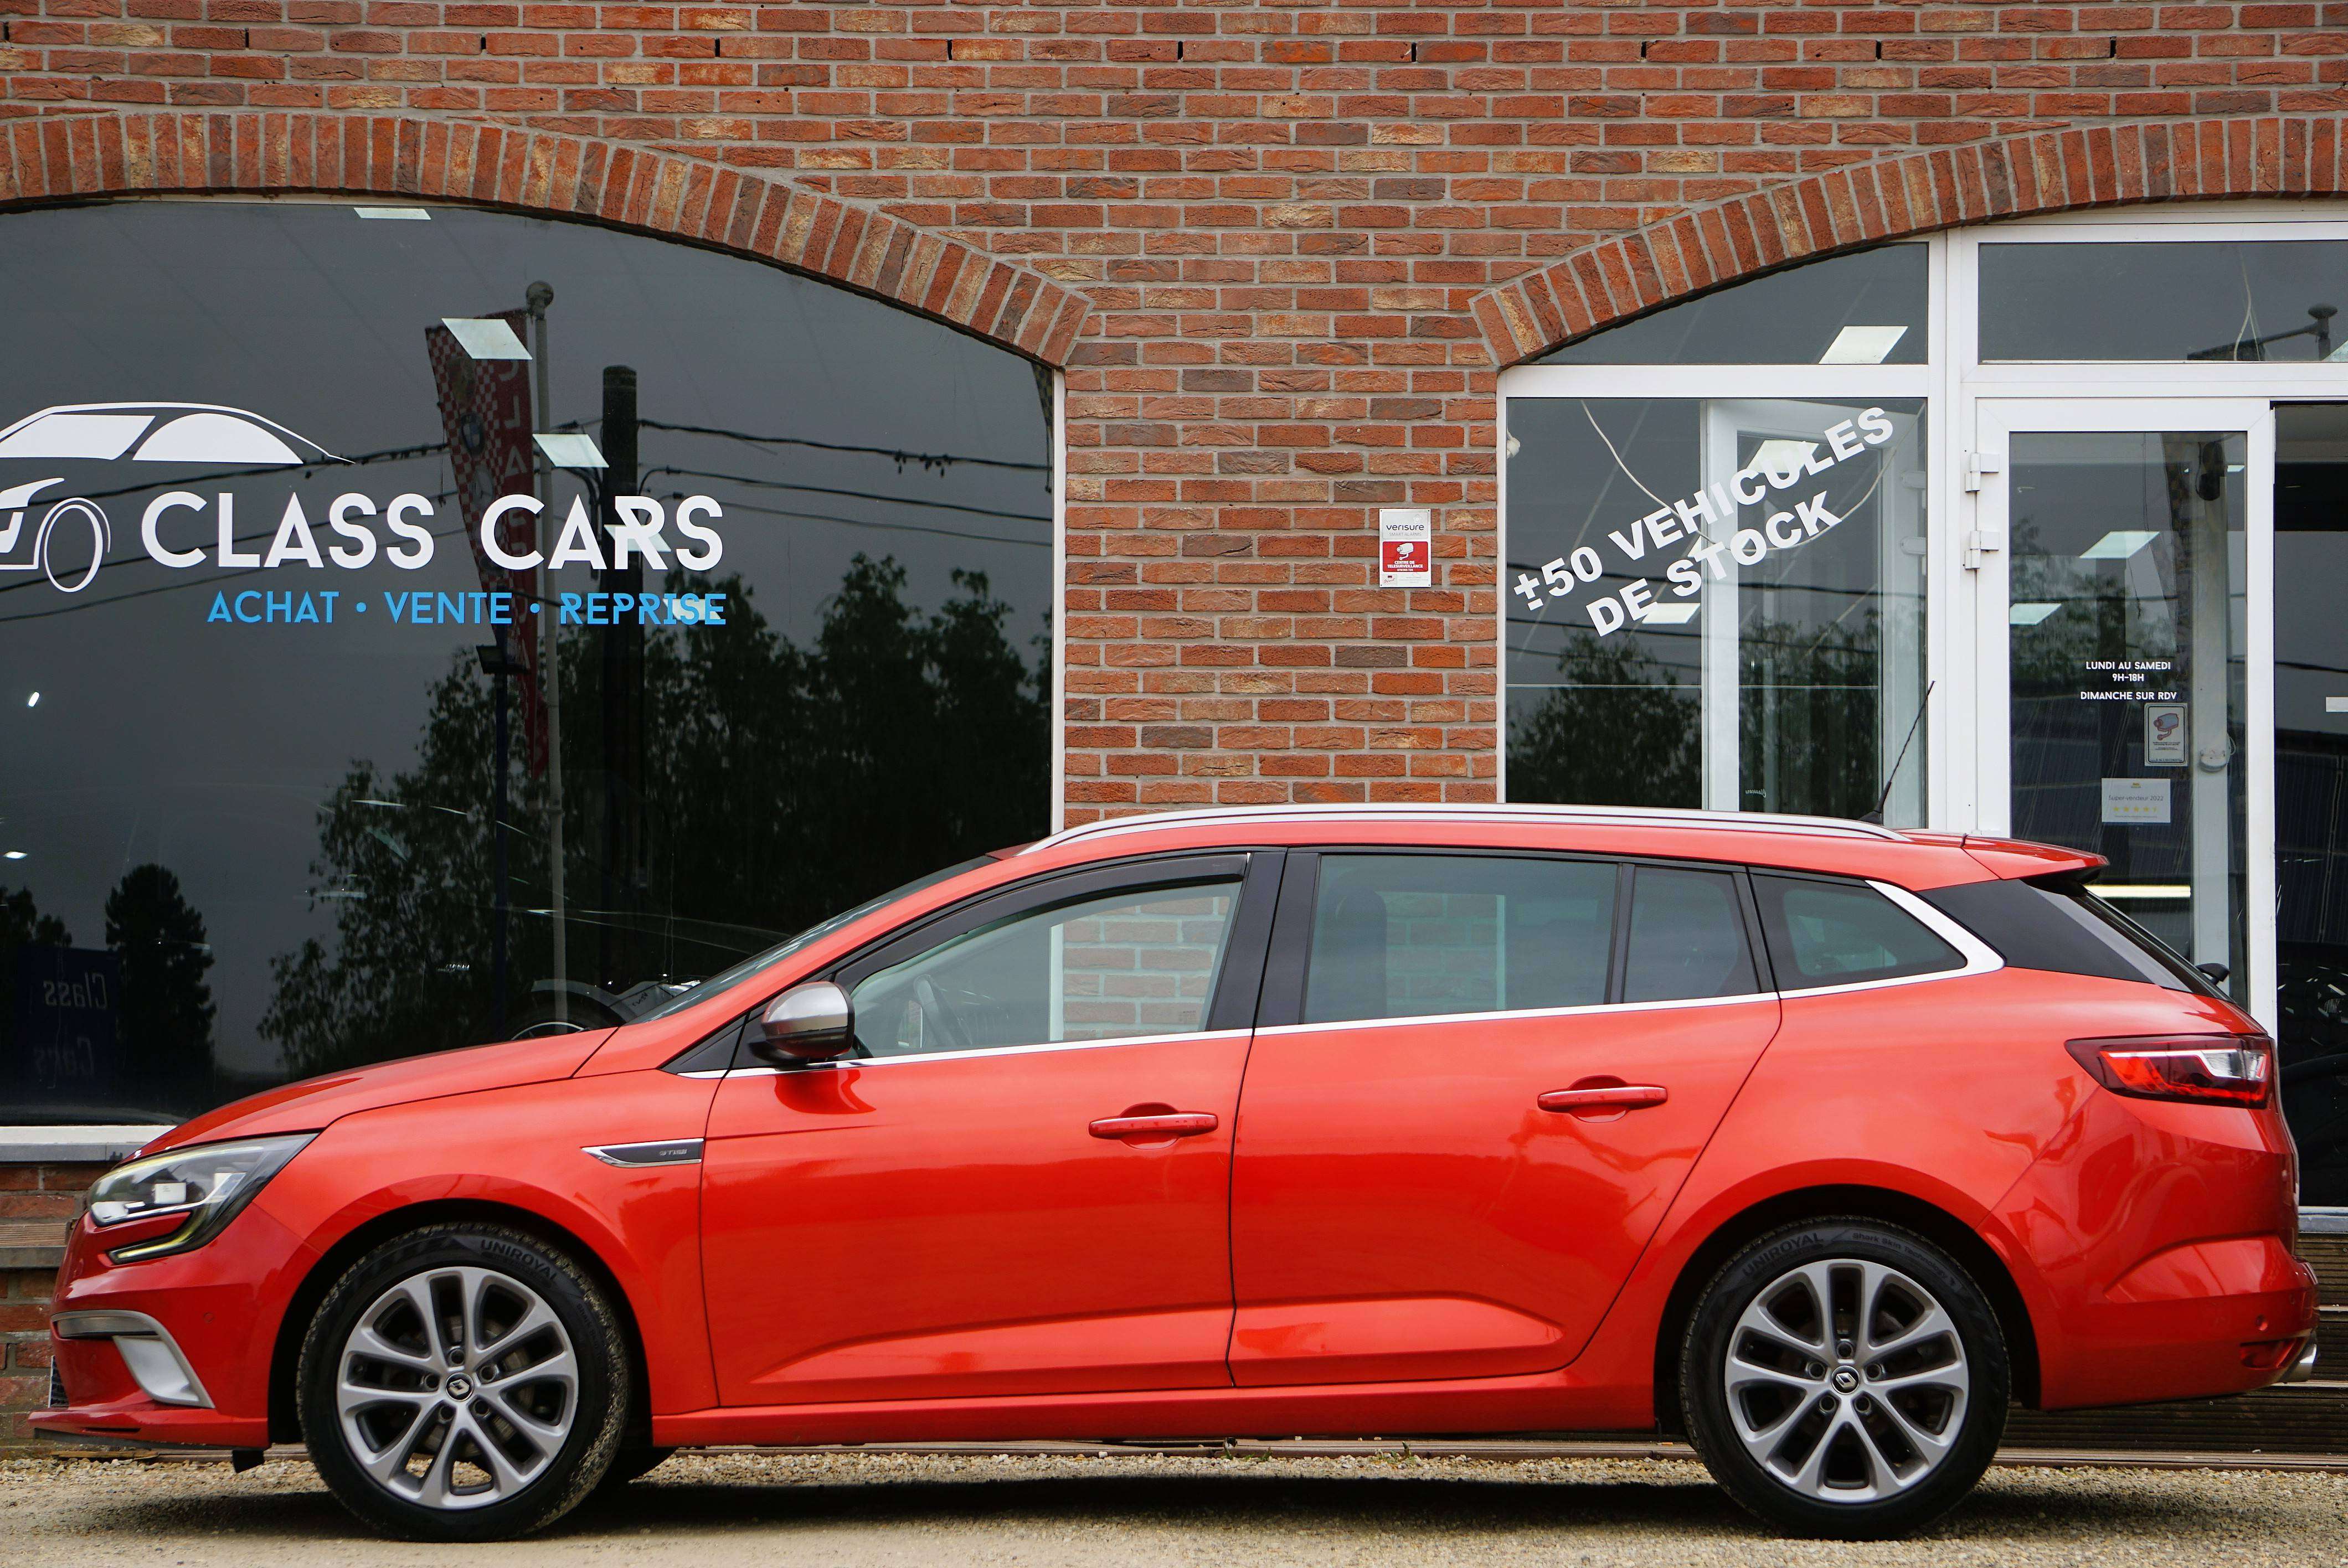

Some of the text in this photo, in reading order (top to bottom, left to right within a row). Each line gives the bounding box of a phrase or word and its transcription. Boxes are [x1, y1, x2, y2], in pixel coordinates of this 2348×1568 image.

[1513, 407, 1893, 611] ±50 VEHICULES
[142, 491, 723, 571] CLASS CARS
[1585, 491, 1842, 637] DE STOCK
[206, 590, 727, 626] ACHAT VENTE REPRISE
[2086, 661, 2171, 670] LUNDI AU SAMEDI
[2112, 673, 2144, 682] 9H-18H
[2080, 692, 2177, 700] DIMANCHE SUR RDV
[1742, 1232, 1824, 1277] UNIROYAL
[1852, 1232, 1880, 1242] Shark
[481, 1239, 558, 1280] UNIROYAL
